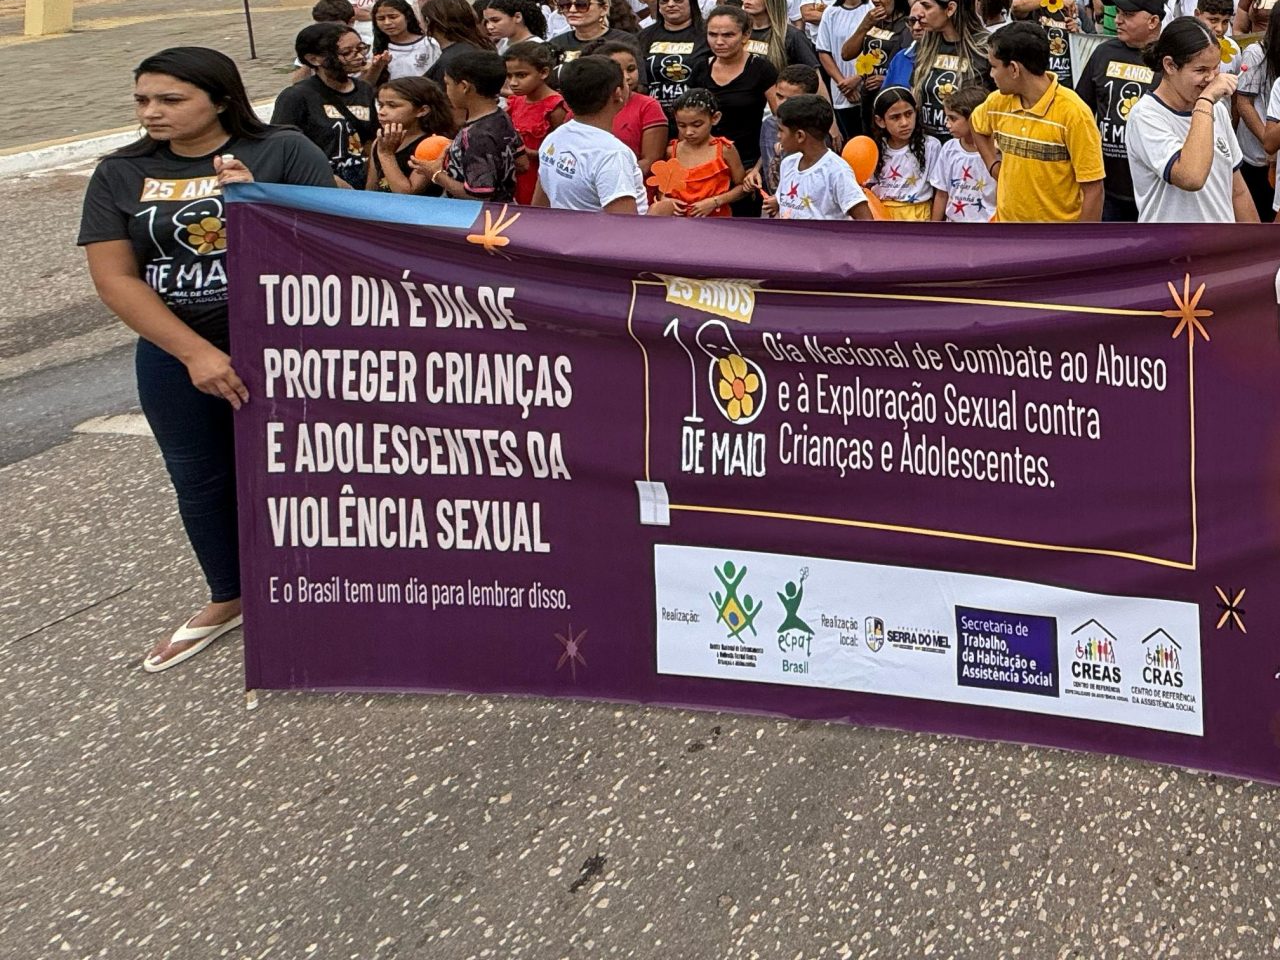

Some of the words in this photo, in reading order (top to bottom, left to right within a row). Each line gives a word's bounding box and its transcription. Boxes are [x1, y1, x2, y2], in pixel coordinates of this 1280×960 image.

[1108, 63, 1121, 75] 25
[1124, 67, 1152, 81] ANOS
[145, 181, 177, 199] 25
[176, 259, 228, 289] MA
[259, 274, 341, 326] TODO
[350, 275, 399, 327] DIA
[401, 269, 427, 327] É
[422, 283, 484, 329] DIA
[478, 287, 527, 331] DE
[698, 283, 752, 316] ANOS
[663, 317, 768, 426] 18
[762, 331, 807, 363] Dia
[803, 334, 910, 369] Nacional
[912, 342, 944, 372] de
[944, 342, 1053, 381] Combate
[1060, 350, 1088, 384] ao
[1095, 343, 1167, 392] Abuso
[263, 348, 417, 403] PROTEGER
[425, 351, 573, 419] CRIANÇAS
[778, 380, 790, 413] e
[797, 372, 810, 414] à
[816, 373, 937, 431] Exploração
[943, 383, 1018, 431] Sexual
[1024, 398, 1101, 440] contra
[266, 422, 286, 473] E
[294, 422, 524, 478] ADOLESCENTES
[527, 431, 573, 480] DA
[681, 426, 706, 475] DE
[711, 431, 767, 478] MAIO
[779, 421, 874, 478] Crianças
[880, 439, 894, 473] e
[900, 431, 1056, 489] Adolescentes.
[267, 484, 429, 549] VIOLÊNCIA
[436, 498, 551, 553] SEXUAL
[269, 576, 279, 603] E
[283, 582, 293, 603] o
[298, 576, 341, 604] Brasil
[344, 580, 374, 604] tem
[377, 583, 401, 604] um
[405, 577, 428, 605] dia
[432, 585, 466, 611] para
[467, 578, 525, 609] lembrar
[528, 582, 572, 610] disso.
[821, 613, 859, 631] Realização
[961, 615, 1013, 634] Secretaria
[1015, 621, 1029, 637] de
[887, 630, 917, 645] SERRA
[918, 633, 931, 646] DO
[933, 635, 951, 649] MEL
[962, 632, 1009, 654] Trabalho,
[782, 660, 809, 674] Brasil
[962, 650, 974, 663] da
[976, 650, 1028, 672] Habitação
[1029, 658, 1037, 671] e
[1071, 661, 1122, 684] CREAS
[962, 664, 1020, 683] Assistência
[1022, 671, 1053, 688] Social
[1142, 666, 1184, 688] CRAS
[1131, 686, 1153, 697] CENTRO
[1154, 689, 1161, 698] DE
[1132, 696, 1140, 704] DA
[1176, 702, 1196, 713] SOCIAL
